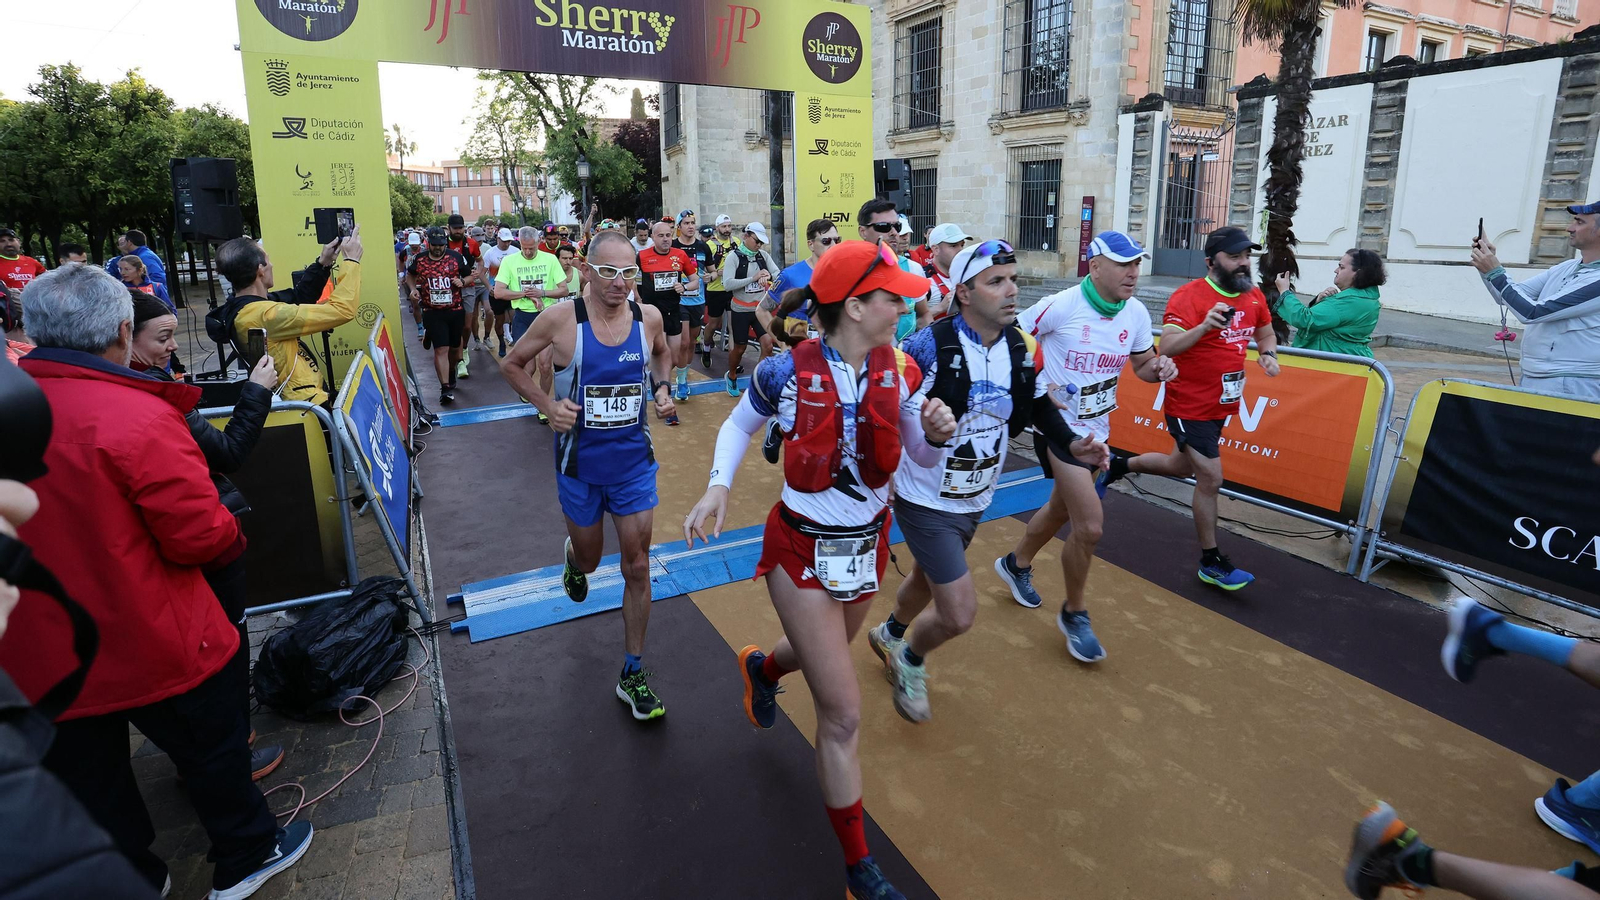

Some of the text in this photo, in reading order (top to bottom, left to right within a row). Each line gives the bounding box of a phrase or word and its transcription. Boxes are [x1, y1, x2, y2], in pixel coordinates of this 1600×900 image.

[278, 0, 337, 14] Maratón
[535, 0, 675, 52] Sherry
[562, 29, 656, 55] Maratón
[807, 39, 858, 62] Sherry
[816, 53, 850, 64] Maratón
[296, 72, 360, 83] Ayuntamiento
[296, 81, 333, 90] de Jerez
[824, 106, 861, 114] Ayuntamiento
[310, 117, 364, 129] Diputación
[1305, 115, 1349, 129] AZAR
[312, 130, 355, 141] de Cádiz
[830, 140, 862, 148] Diputación
[1303, 143, 1333, 157] REZ
[840, 149, 857, 157] Cádiz
[330, 162, 354, 170] JEREZ
[822, 212, 850, 223] HSN
[516, 264, 548, 275] RUN FAST
[427, 276, 451, 290] LEÃO
[357, 303, 381, 318] VALDESPIN
[320, 349, 363, 357] CVIJERE
[1095, 390, 1108, 406] 82
[603, 397, 627, 413] 148
[1134, 415, 1152, 427] WE
[1217, 437, 1280, 459] RITION!
[965, 470, 983, 486] 40
